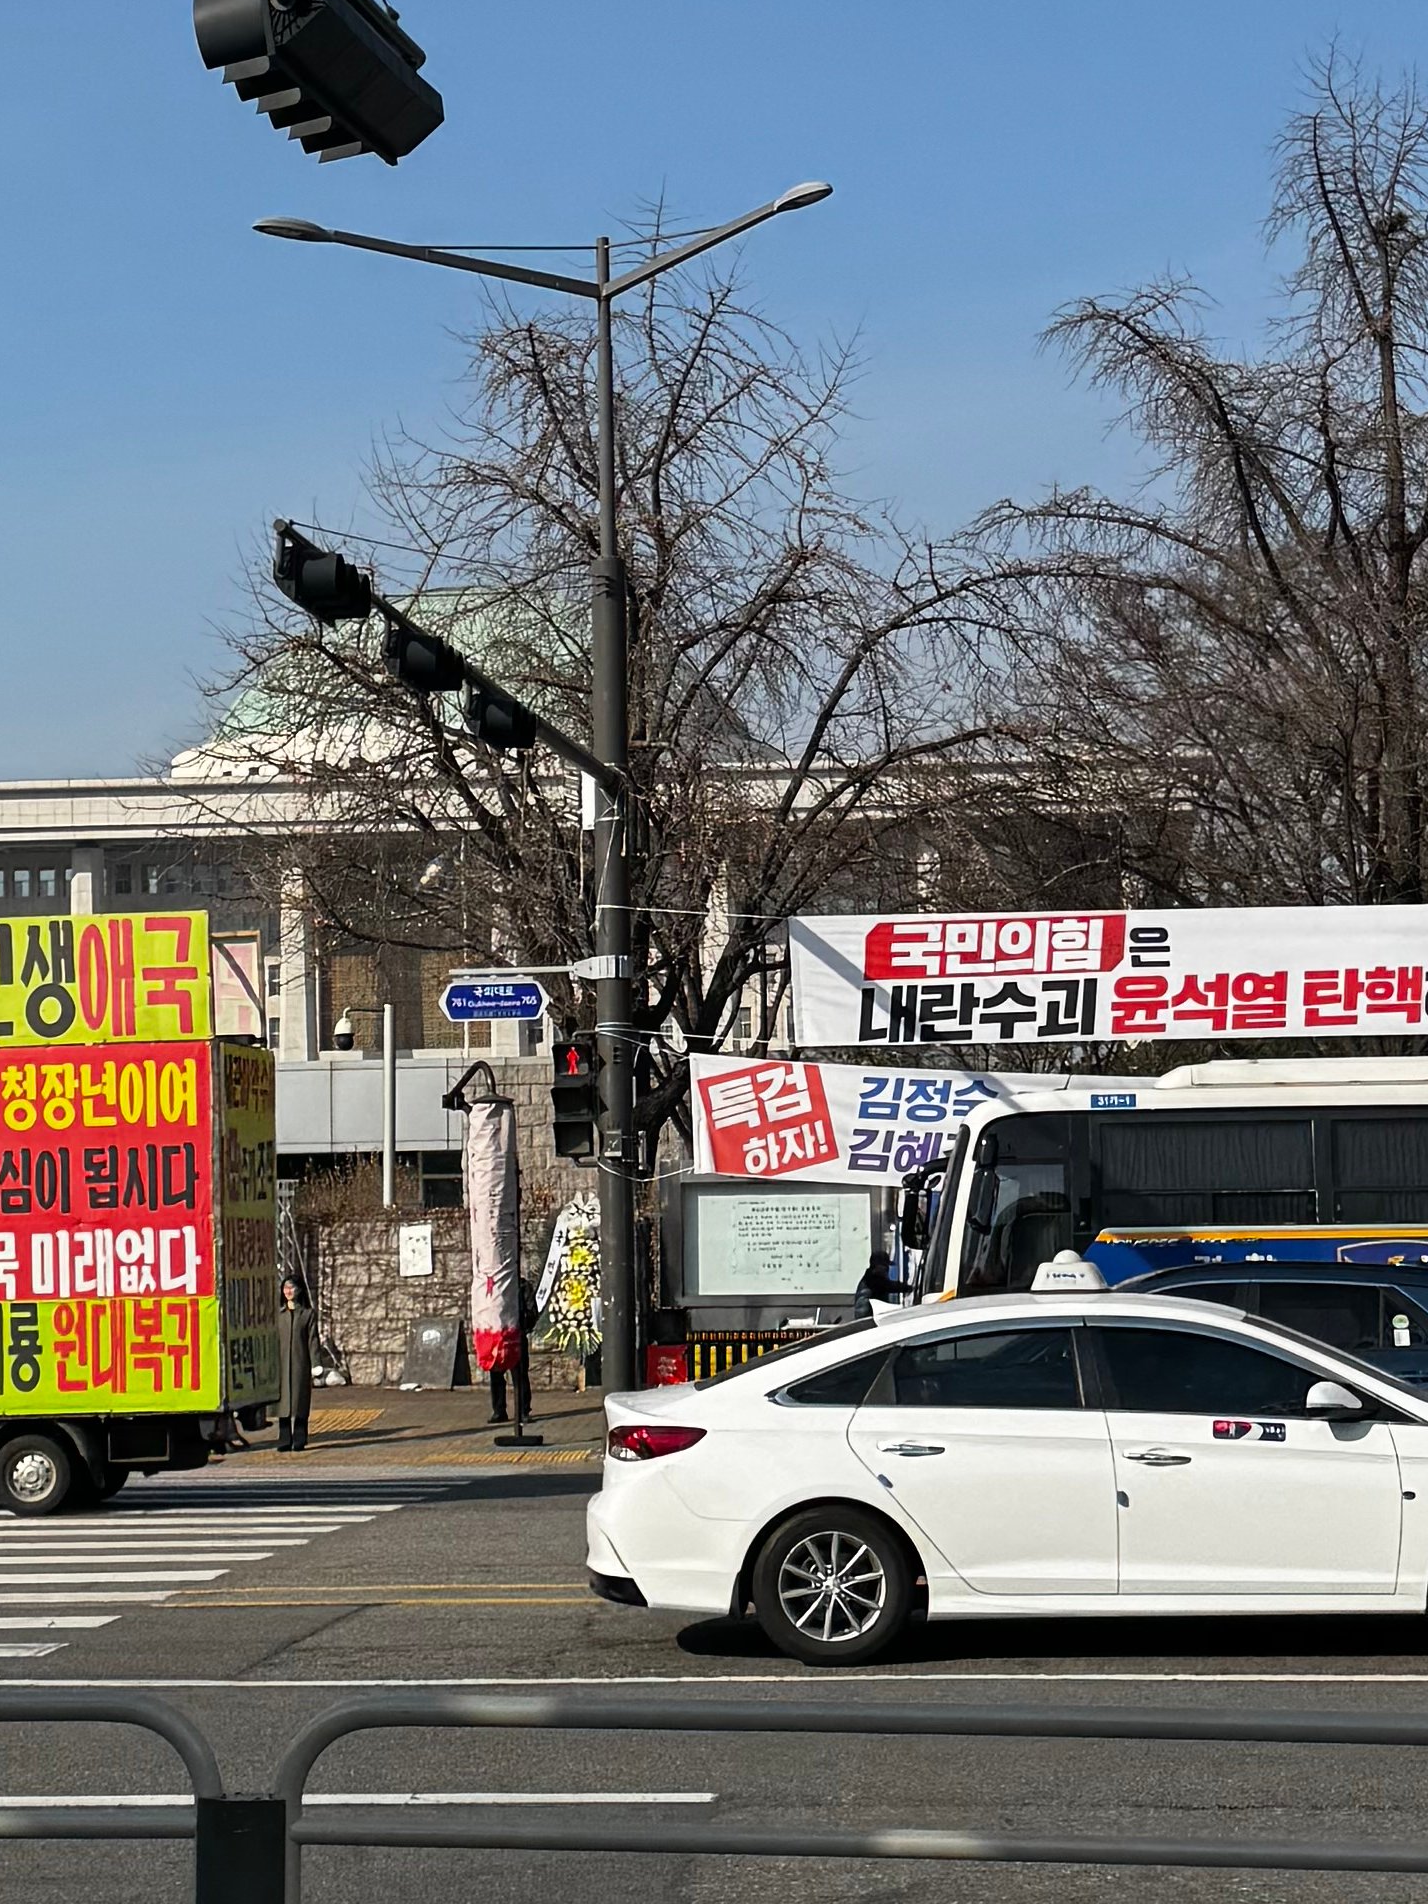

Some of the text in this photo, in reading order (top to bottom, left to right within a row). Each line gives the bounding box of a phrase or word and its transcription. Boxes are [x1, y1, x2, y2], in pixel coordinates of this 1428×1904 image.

[858, 977, 1098, 1043] 내란수괴
[1110, 970, 1288, 1035] 윤석열
[1, 1058, 198, 1130] 청장년이여
[707, 1062, 813, 1130] 특검
[85, 1143, 199, 1212] 됩시다
[742, 1120, 829, 1174] 하자!
[847, 1128, 960, 1173] 김혜
[31, 1225, 202, 1297] 미래없다
[53, 1299, 201, 1395] 원대복귀
